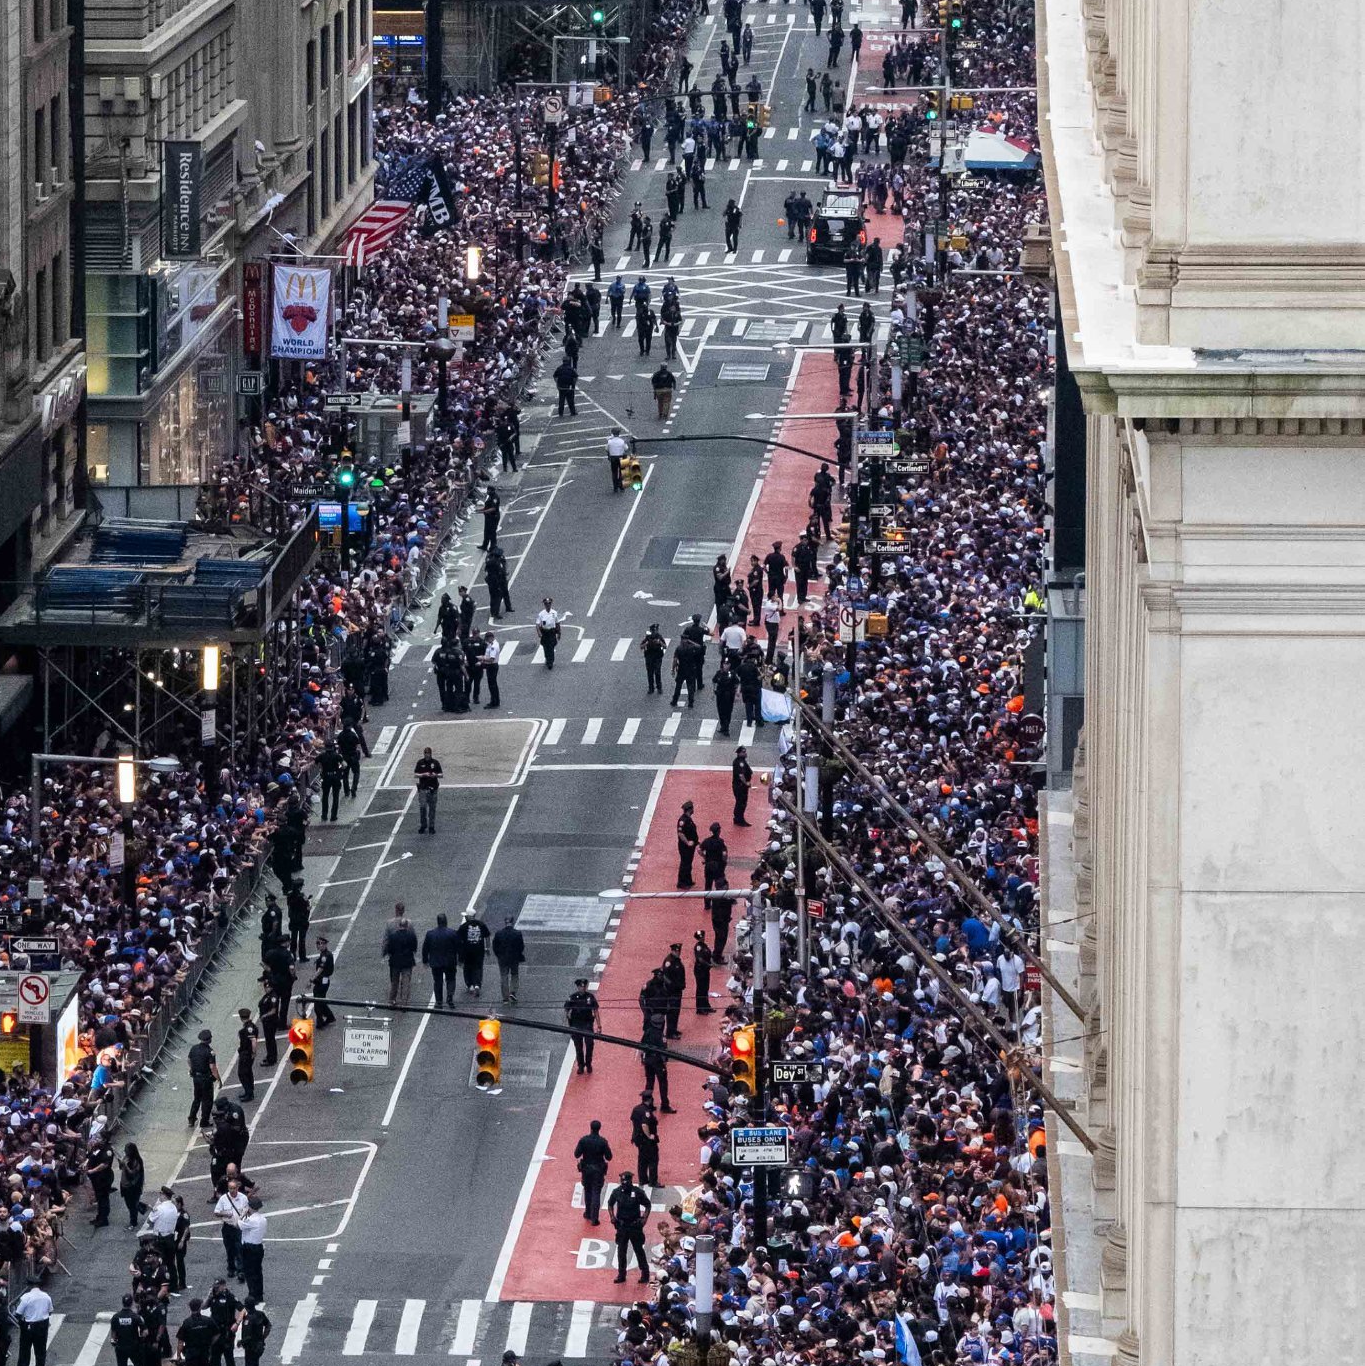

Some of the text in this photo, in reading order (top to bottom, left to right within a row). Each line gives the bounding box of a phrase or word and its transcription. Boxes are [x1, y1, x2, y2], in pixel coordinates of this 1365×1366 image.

[178, 152, 192, 231] Residence
[282, 338, 315, 347] WORLD
[272, 346, 325, 355] CHAMPIONS
[242, 378, 256, 388] GAP
[293, 487, 317, 495] Maiden
[877, 544, 904, 552] Cortlandt
[776, 1068, 795, 1082] Dey
